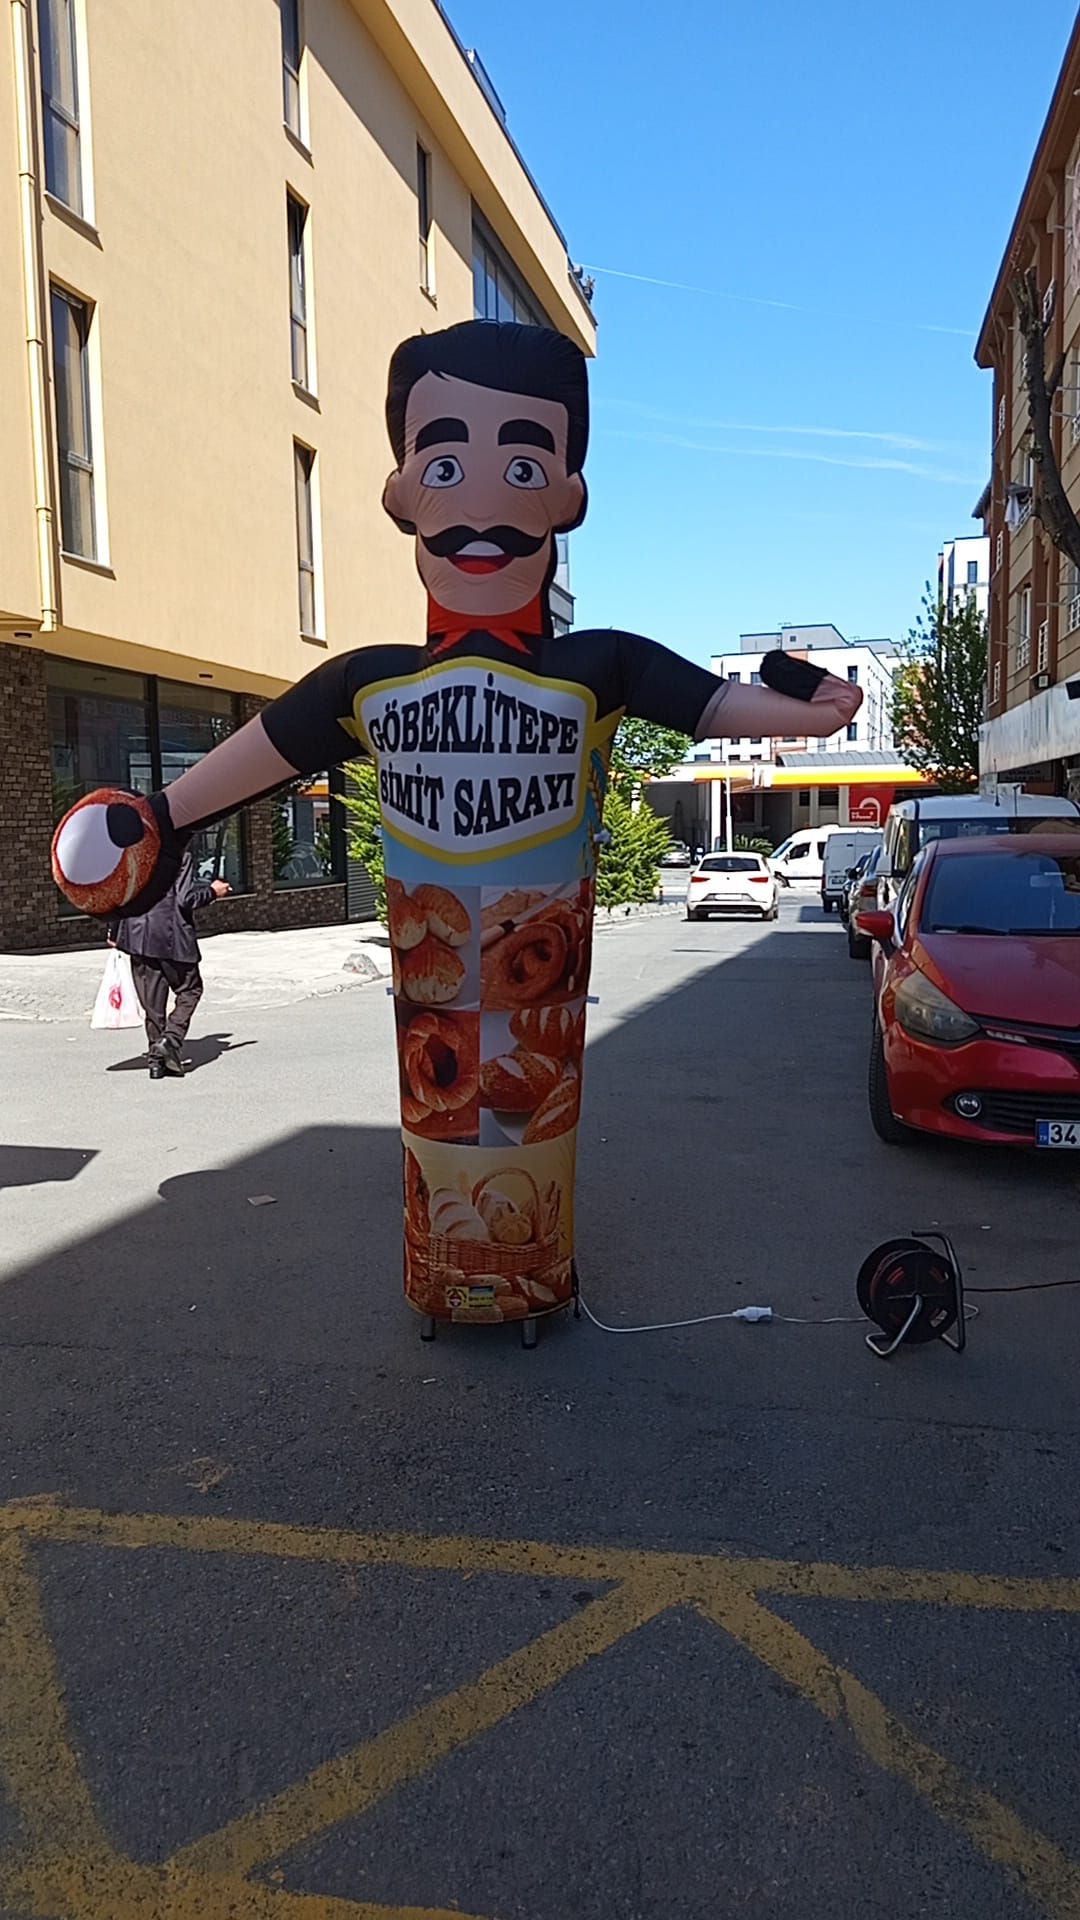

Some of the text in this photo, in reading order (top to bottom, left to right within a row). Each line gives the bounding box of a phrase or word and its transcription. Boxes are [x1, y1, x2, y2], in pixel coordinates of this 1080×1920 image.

[368, 672, 578, 754] GÖBEKLİTEPE
[380, 762, 576, 837] SİMİT SARAYI
[1050, 1124, 1077, 1145] 34
